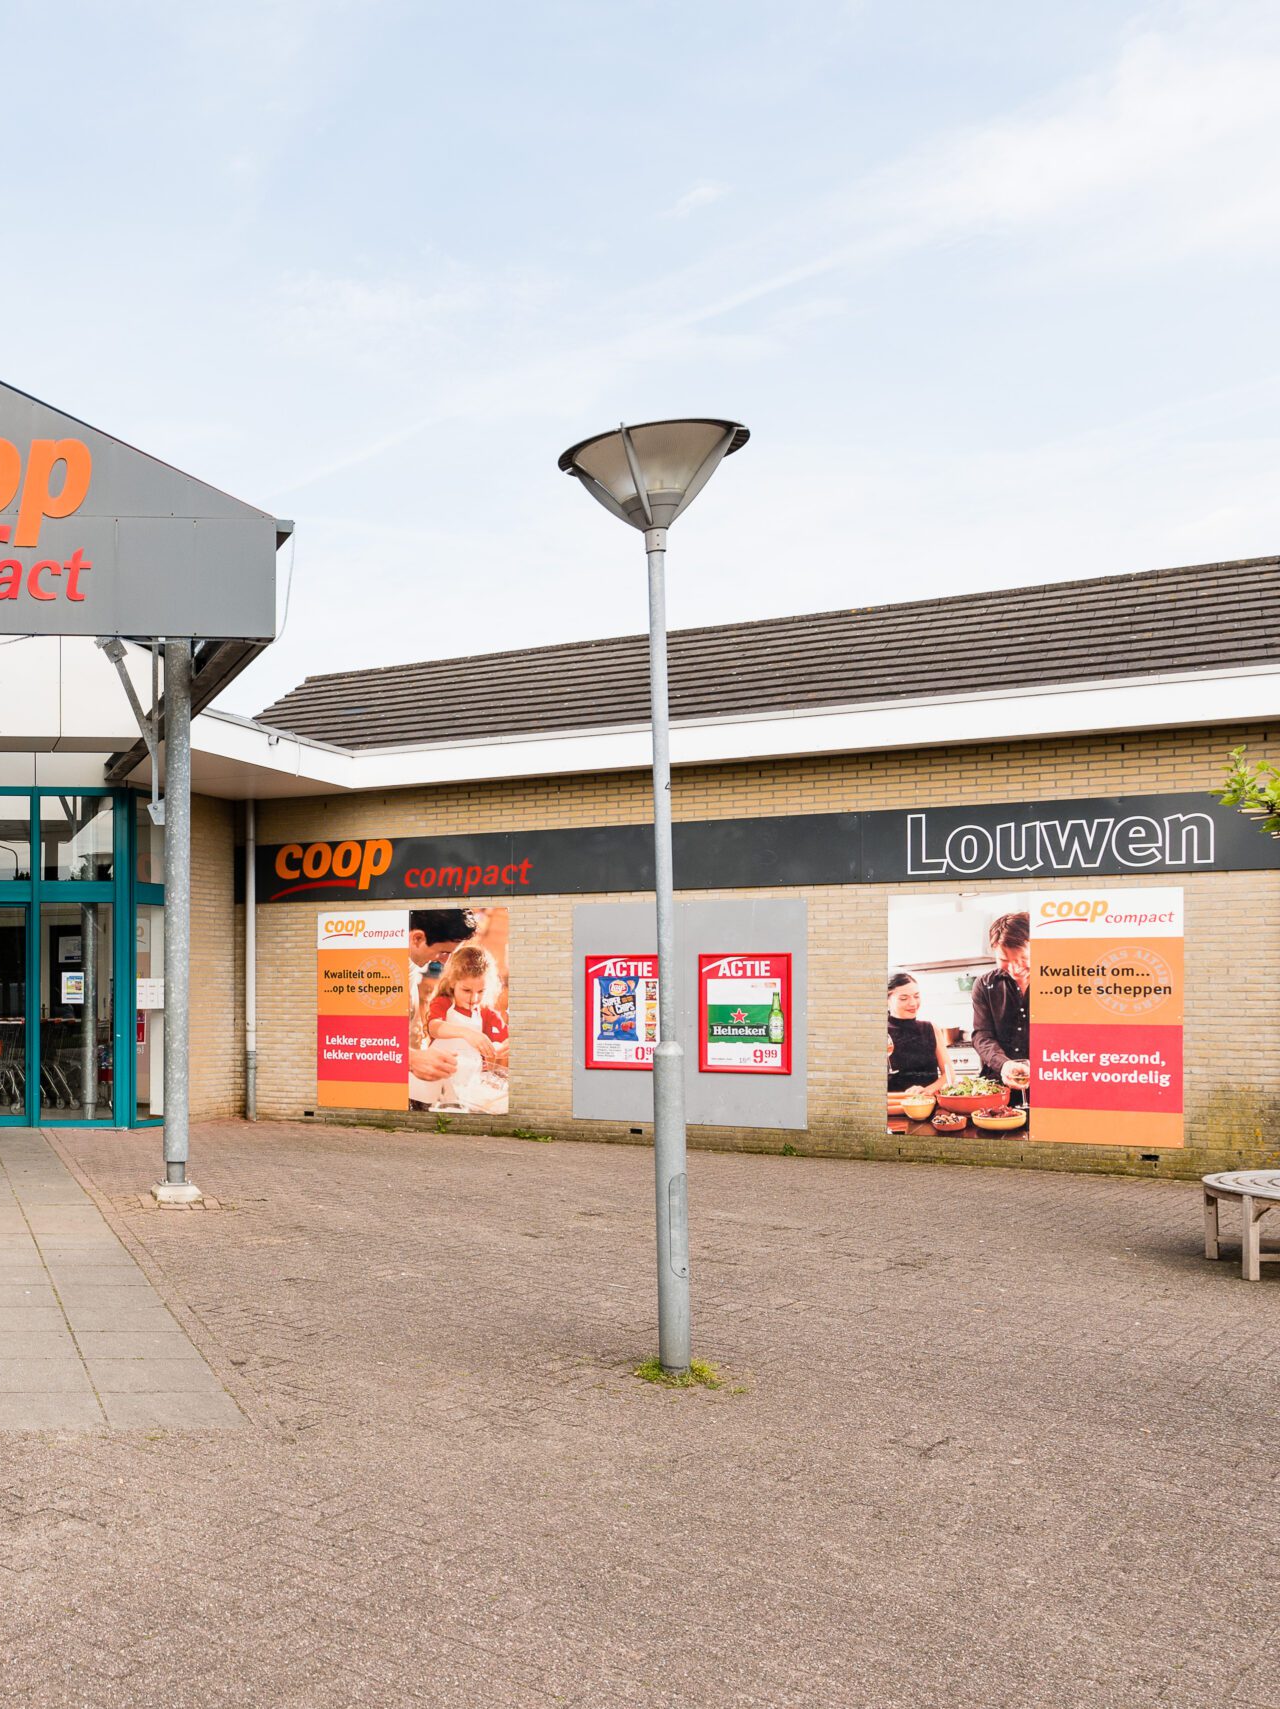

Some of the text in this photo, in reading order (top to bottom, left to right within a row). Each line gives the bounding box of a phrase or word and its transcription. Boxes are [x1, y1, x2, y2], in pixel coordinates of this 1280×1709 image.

[907, 812, 1215, 875] Louwen
[275, 838, 534, 894] coop compact
[1040, 900, 1176, 926] coop compact
[324, 919, 405, 940] coop compact
[324, 969, 390, 979] Kwaliteit om...
[603, 961, 653, 977] ACTIE
[717, 960, 771, 977] ACTIE
[1040, 965, 1150, 977] Kwaliteit om...
[324, 983, 404, 995] ...op te scheppen
[1039, 983, 1173, 998] ...op te scheppen
[712, 1025, 767, 1036] Heineken
[325, 1035, 400, 1048] Lekker gezond,
[323, 1049, 403, 1064] lekker voordelig
[1042, 1049, 1167, 1067] Lekker gezond,
[1038, 1068, 1172, 1087] lekker voordelig
